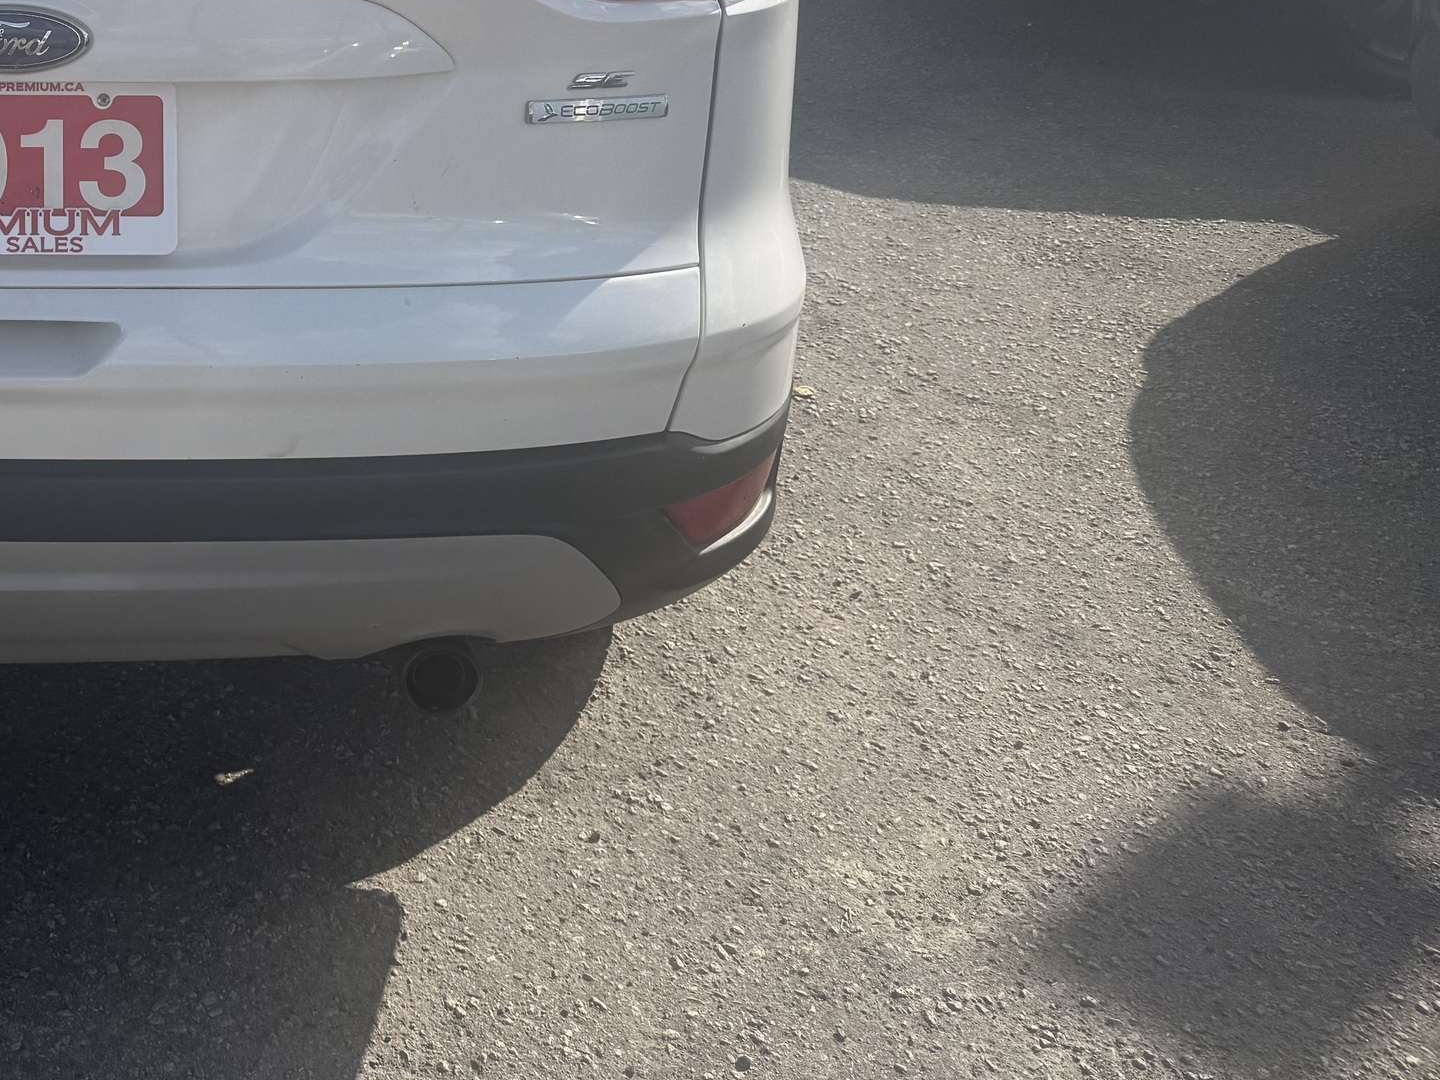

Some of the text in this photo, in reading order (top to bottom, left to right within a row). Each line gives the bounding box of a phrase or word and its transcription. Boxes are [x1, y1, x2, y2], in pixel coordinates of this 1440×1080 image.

[566, 70, 636, 90] SE
[560, 102, 661, 117] ECOBOOST
[6, 236, 84, 253] SALES
